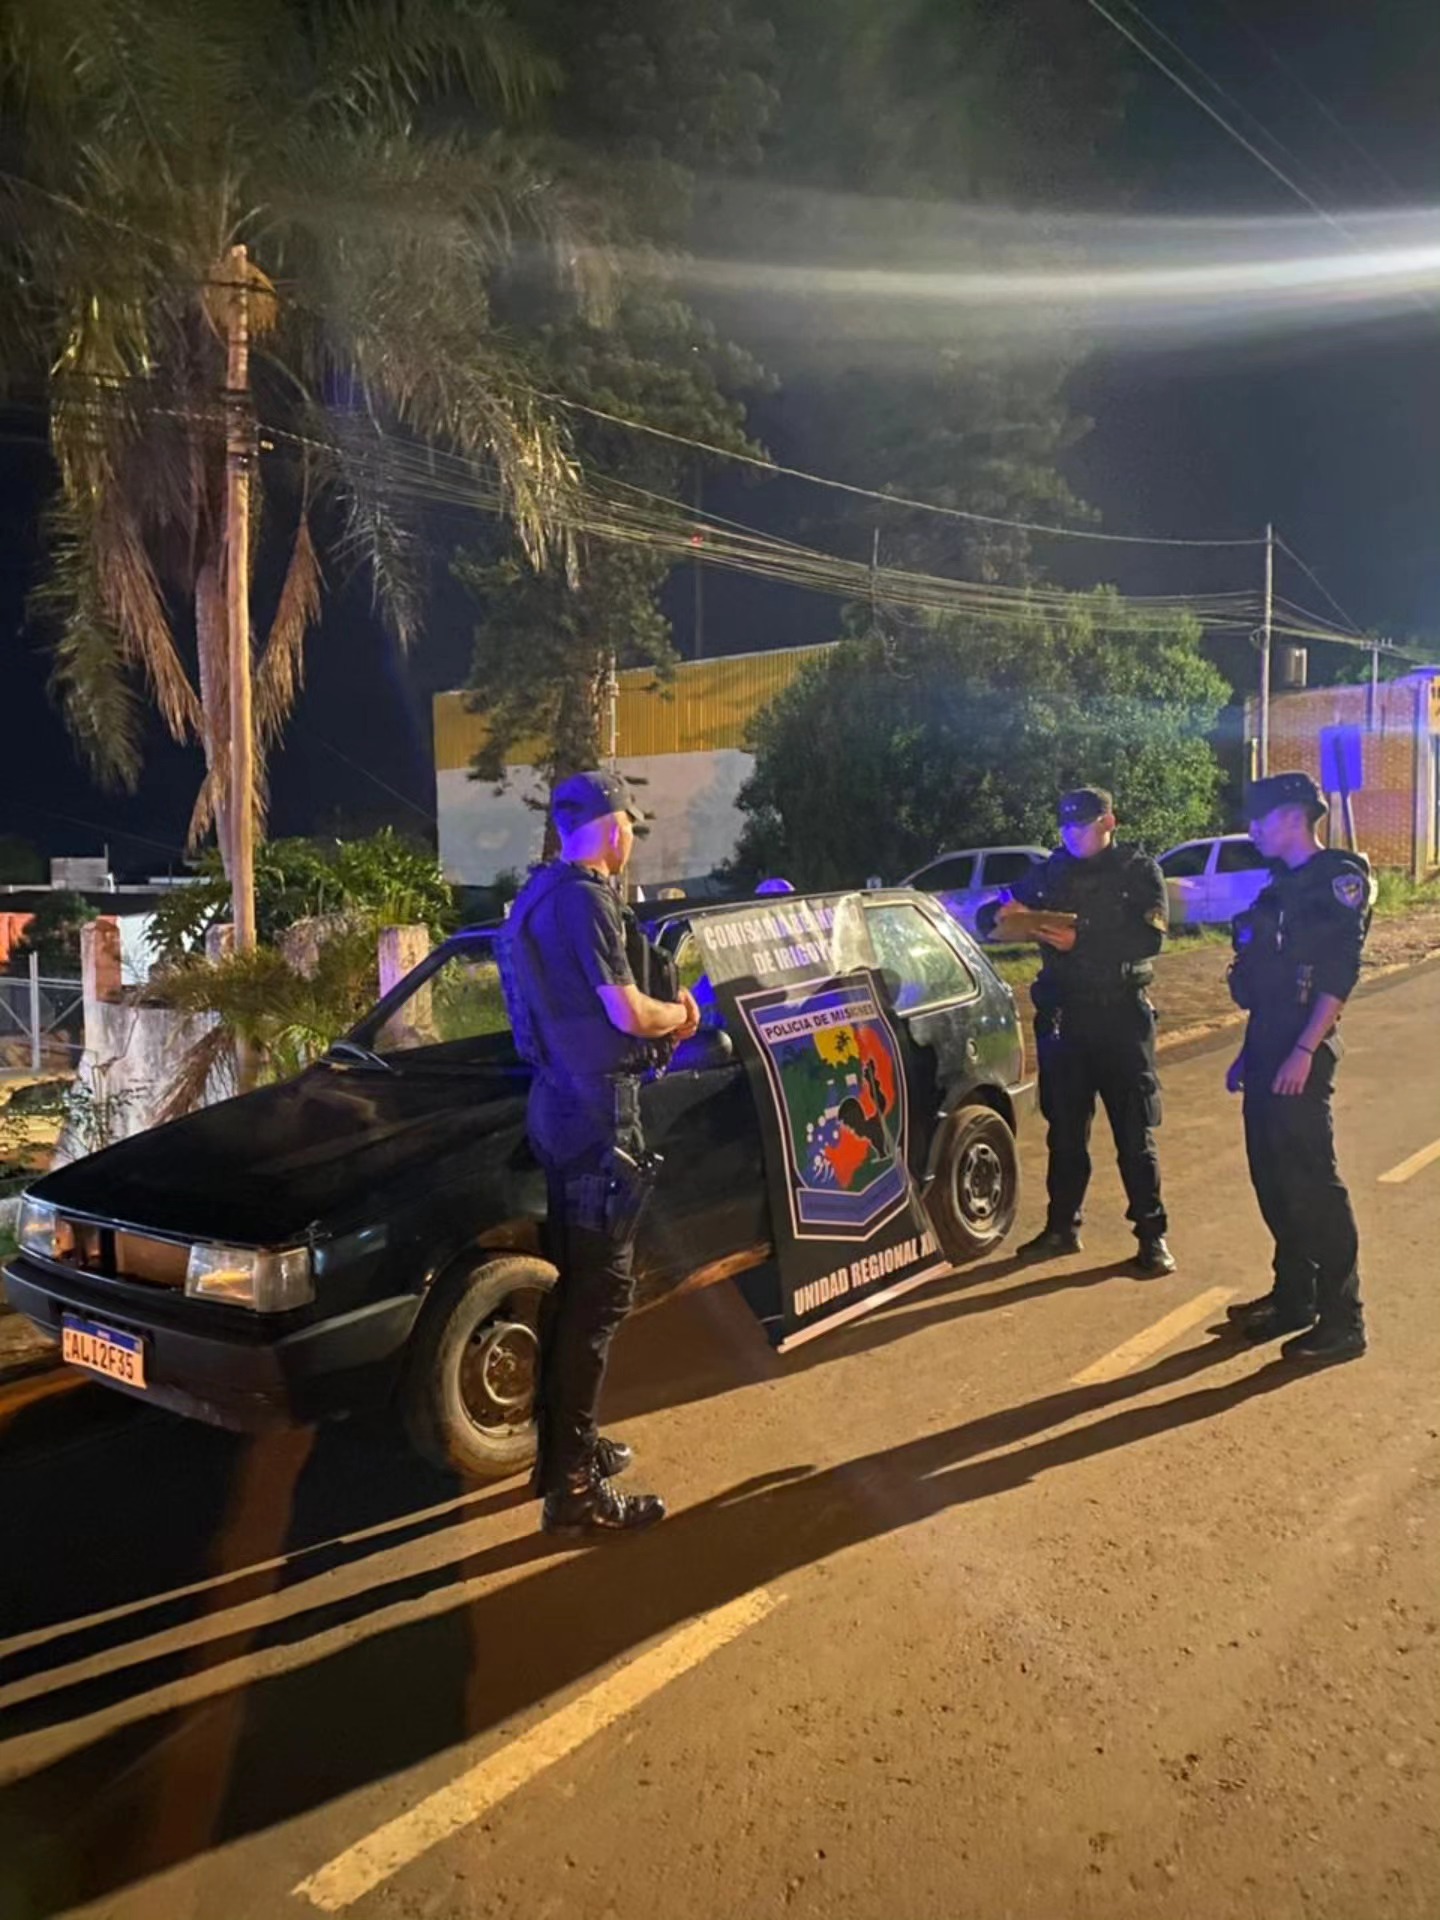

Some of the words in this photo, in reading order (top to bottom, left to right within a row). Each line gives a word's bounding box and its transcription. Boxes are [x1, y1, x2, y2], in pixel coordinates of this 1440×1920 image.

[752, 951, 778, 975] DE
[764, 1019, 813, 1039] POLICIA
[812, 1013, 829, 1026] DE
[793, 1267, 849, 1316] UNIDAD
[850, 1238, 919, 1288] REGIONAL
[71, 1333, 134, 1380] ALI2F35
